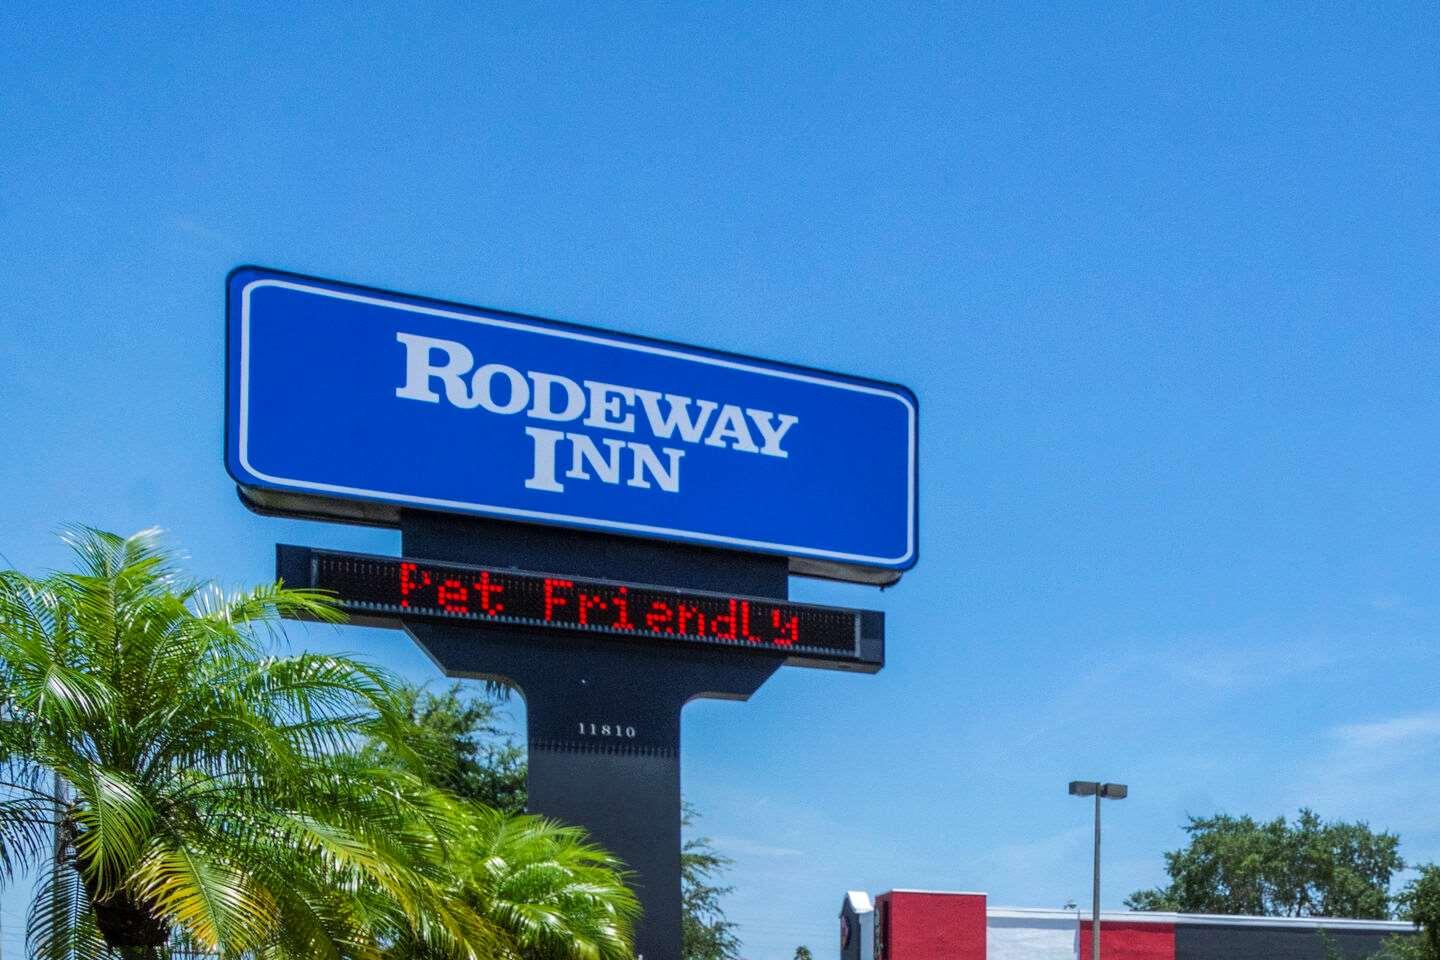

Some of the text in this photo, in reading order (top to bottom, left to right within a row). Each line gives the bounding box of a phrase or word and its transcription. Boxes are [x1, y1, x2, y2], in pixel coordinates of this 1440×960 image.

[395, 331, 799, 458] RODEWAY
[524, 426, 686, 493] INN
[401, 562, 799, 645] Pet Friendly
[578, 722, 636, 738] 11810
